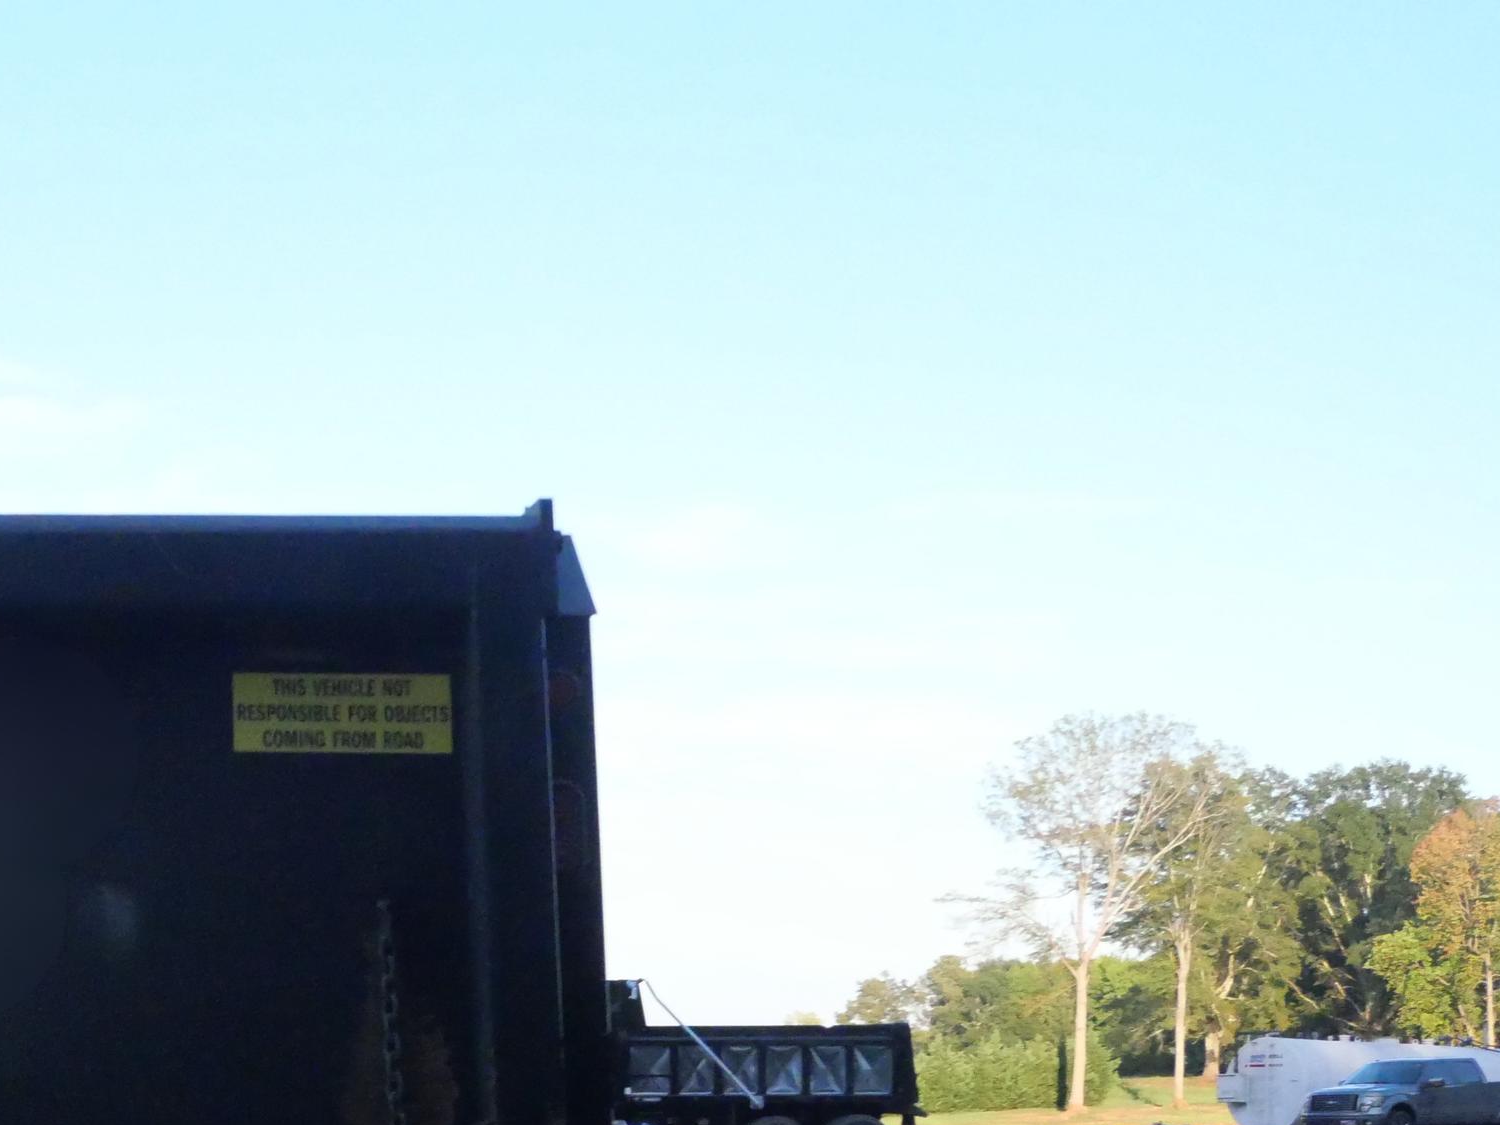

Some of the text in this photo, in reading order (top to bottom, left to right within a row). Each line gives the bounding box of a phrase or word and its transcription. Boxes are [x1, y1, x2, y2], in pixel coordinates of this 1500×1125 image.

[273, 678, 412, 697] THIS VEHICLE NOT
[237, 704, 450, 723] RESPONSIBLE FOR OBJECTS
[262, 729, 425, 749] COMING FROM ROAD
